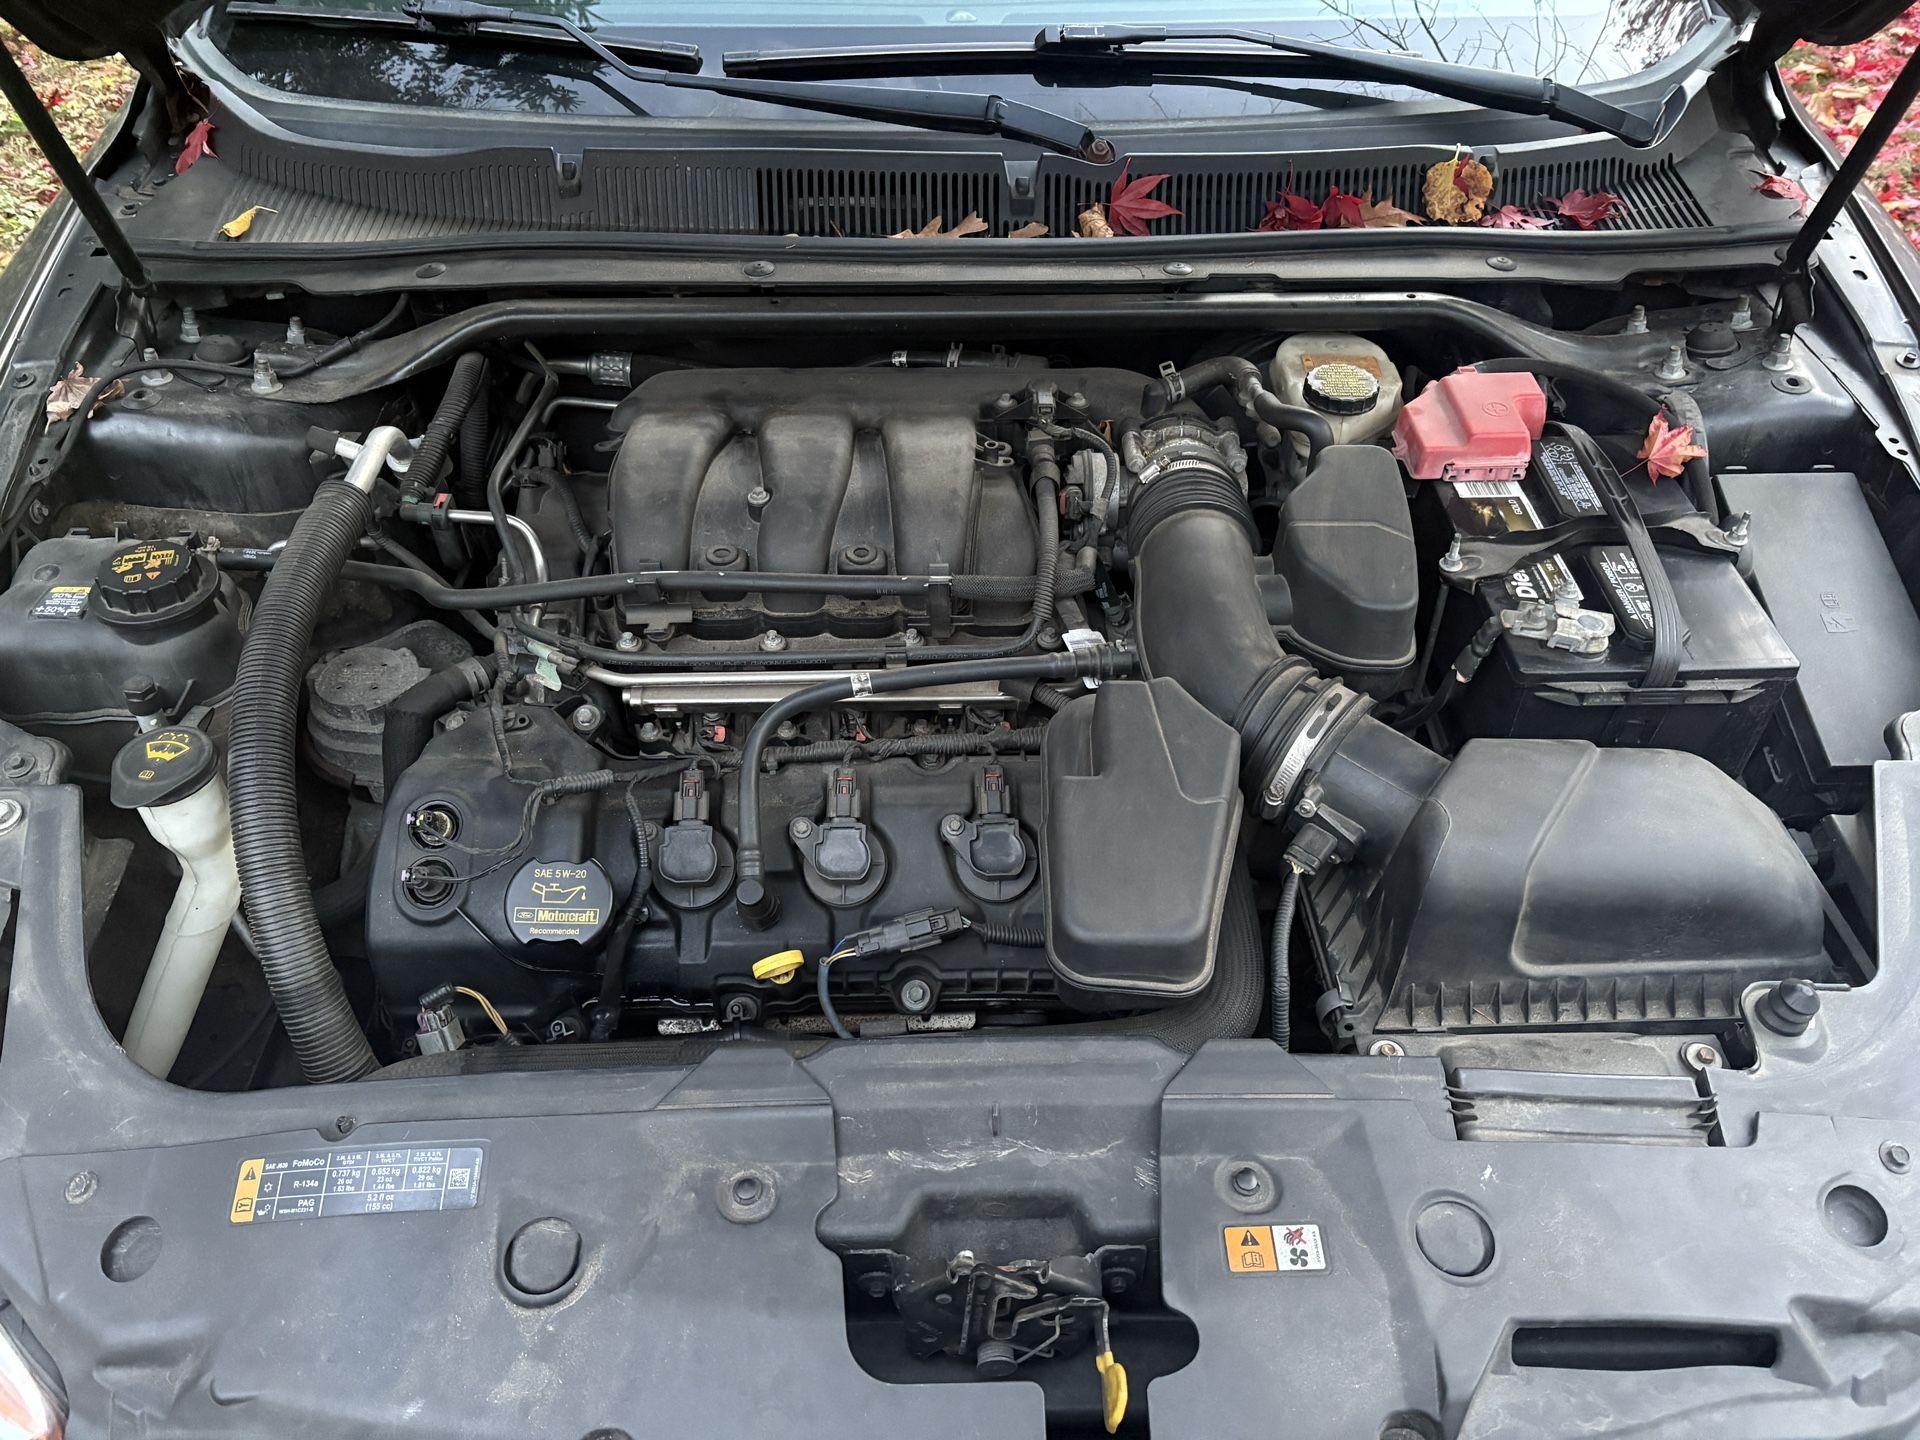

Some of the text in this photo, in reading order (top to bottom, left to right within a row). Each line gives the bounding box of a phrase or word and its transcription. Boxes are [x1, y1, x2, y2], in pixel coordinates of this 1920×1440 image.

[1600, 562, 1619, 584] POISON
[1616, 589, 1636, 614] DANGER
[534, 869, 553, 878] SAE
[538, 909, 595, 922] Motorcraft
[529, 927, 580, 936] Recommended
[292, 1157, 325, 1168] FoMoCo
[332, 1169, 361, 1178] 0.737 kg
[371, 1167, 401, 1177] 0.652 kg
[412, 1166, 442, 1175] 0.822 kg
[293, 1179, 319, 1189] R-134a
[367, 1193, 378, 1202] 5.2
[297, 1199, 315, 1207] PAG
[365, 1201, 393, 1213] (155 cc)
